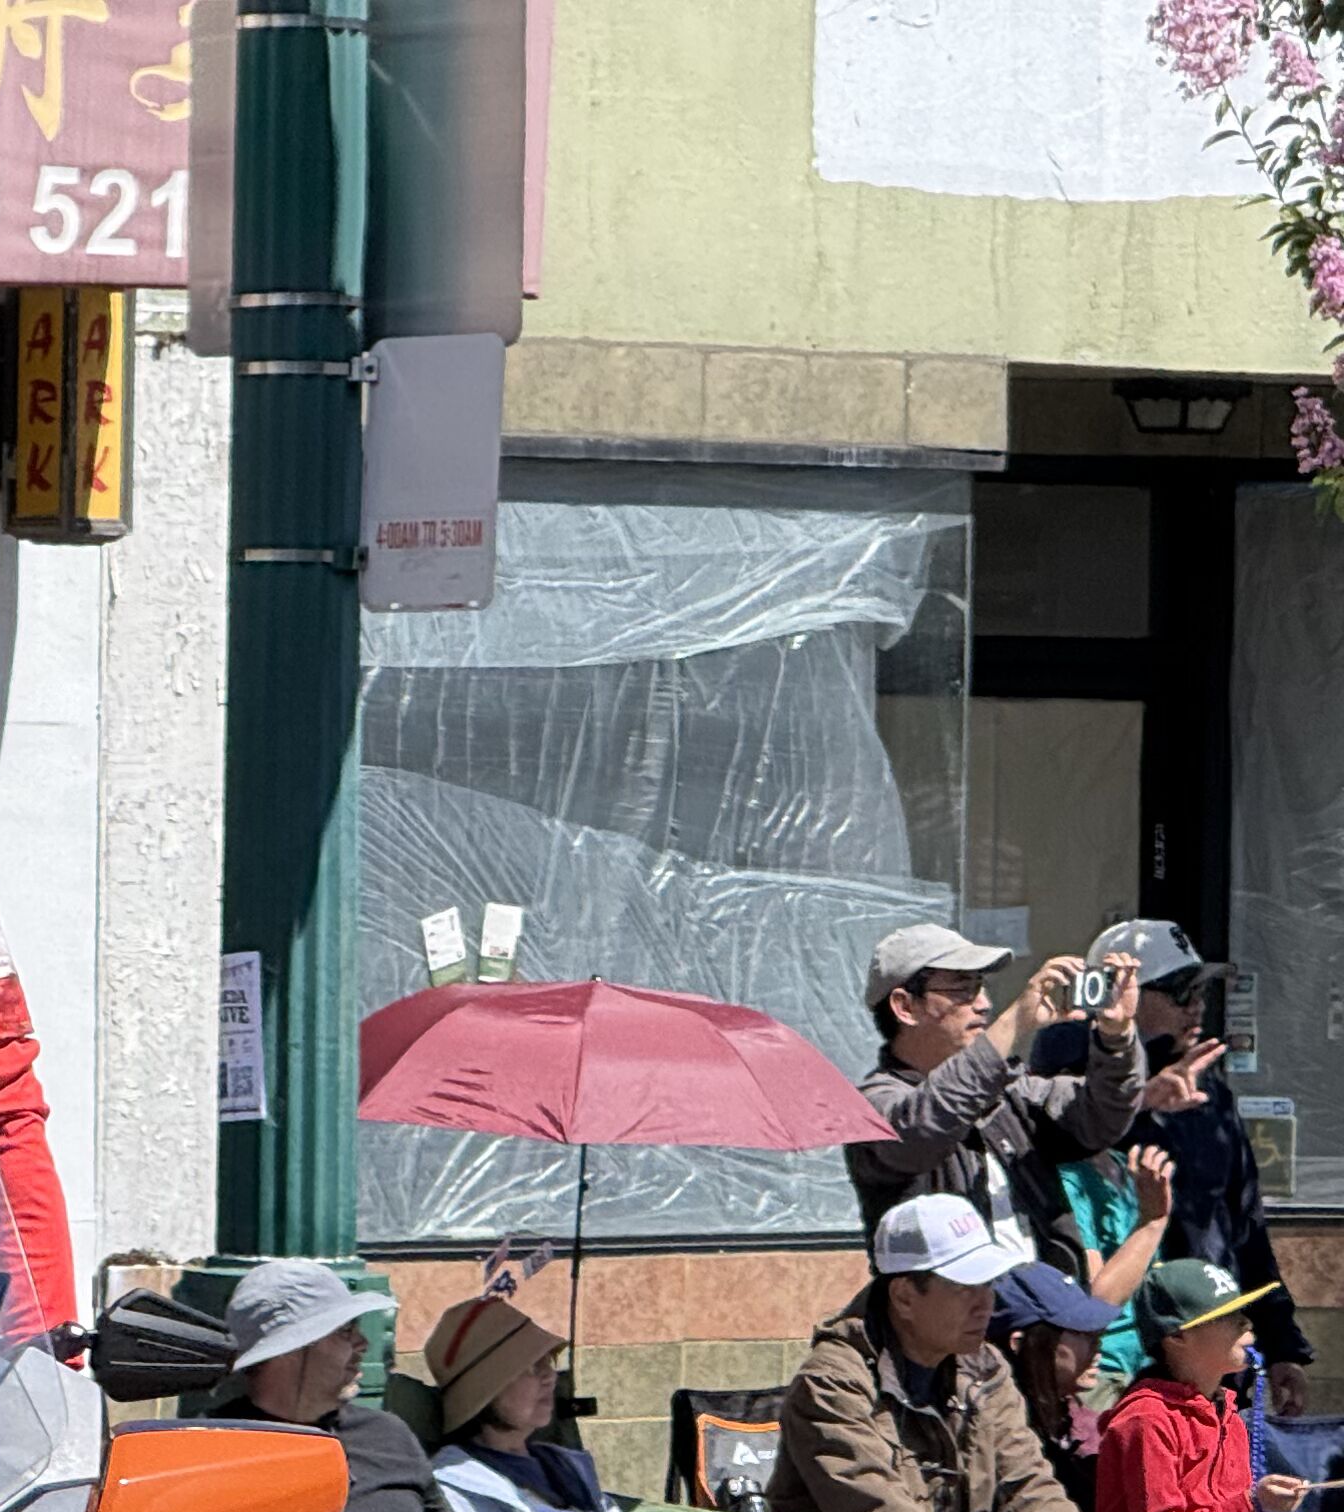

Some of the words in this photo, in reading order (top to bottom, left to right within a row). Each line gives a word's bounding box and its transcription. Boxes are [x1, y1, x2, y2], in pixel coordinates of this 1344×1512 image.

[30, 165, 189, 257] 521
[26, 313, 54, 492] ARK
[82, 314, 113, 493] ARK
[422, 521, 436, 548] TO
